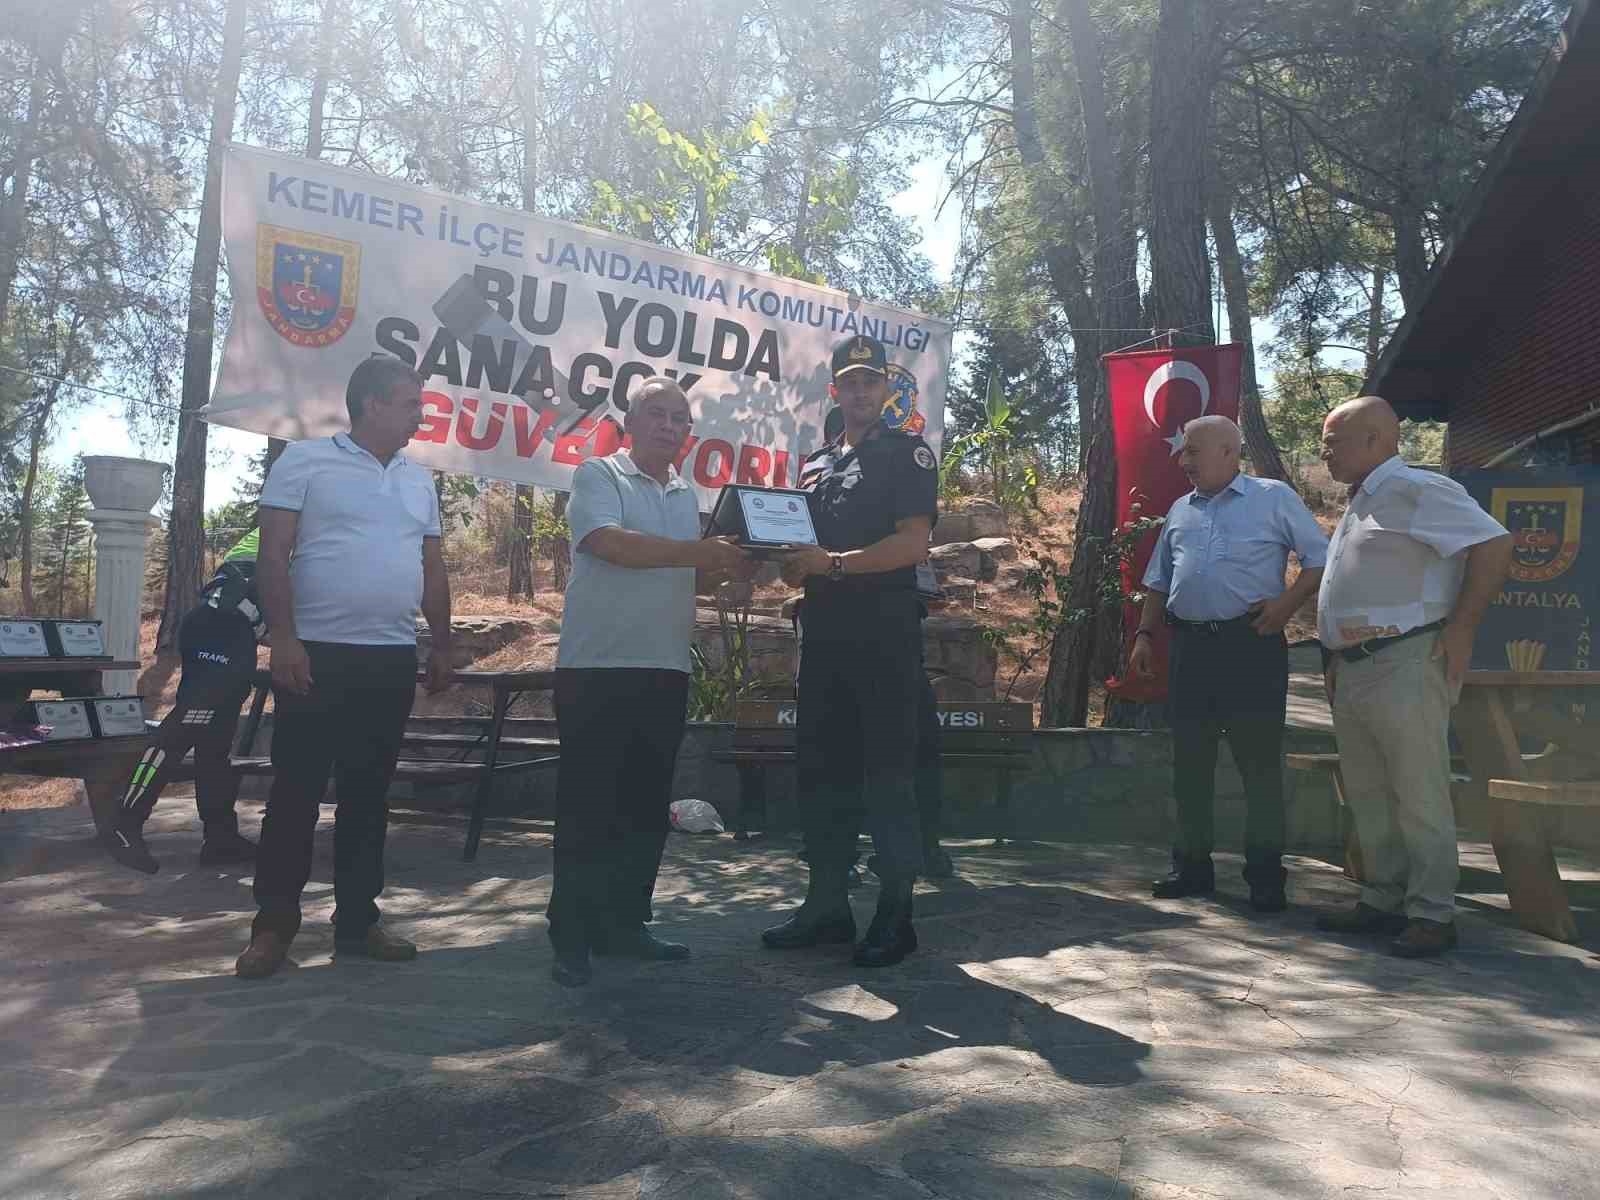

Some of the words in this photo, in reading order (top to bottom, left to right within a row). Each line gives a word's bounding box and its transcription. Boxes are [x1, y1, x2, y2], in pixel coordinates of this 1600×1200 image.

[268, 171, 424, 236] KEMER
[437, 205, 524, 258] İLÇE
[536, 237, 728, 306] JANDARMA
[737, 286, 931, 354] KOMUTANLIĞI
[374, 317, 554, 399] SANA
[475, 264, 568, 336] BU
[597, 290, 781, 382] YOLDA
[1491, 591, 1582, 609] NTALYA
